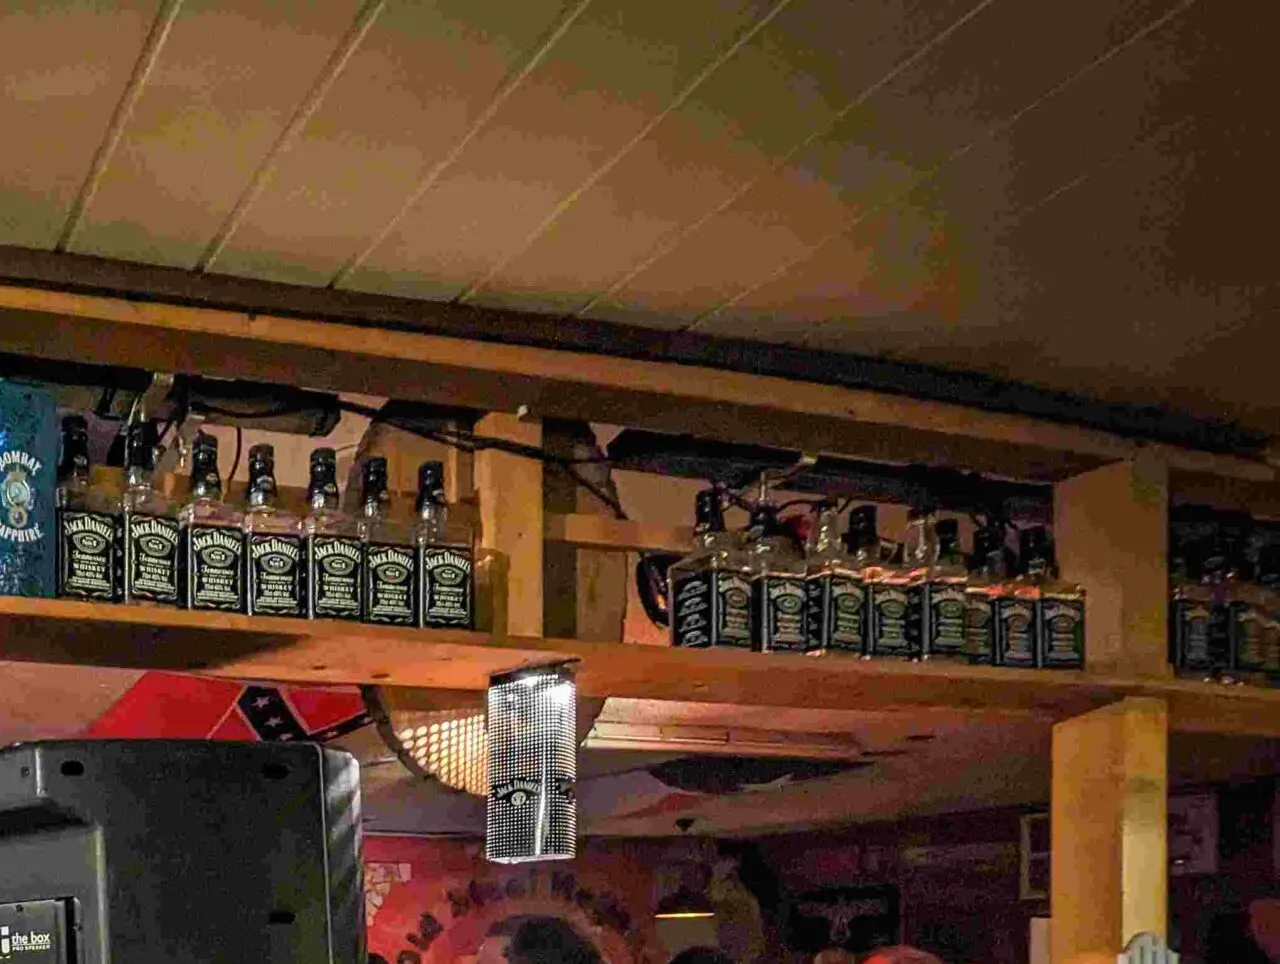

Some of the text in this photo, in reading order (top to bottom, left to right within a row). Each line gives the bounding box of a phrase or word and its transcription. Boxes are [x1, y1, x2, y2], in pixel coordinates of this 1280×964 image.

[63, 520, 84, 536] JACK
[131, 523, 151, 538] JACK
[193, 535, 214, 551] JACK
[251, 543, 272, 558] JACK
[314, 546, 334, 560] JACK
[368, 554, 388, 568] JACK
[425, 556, 444, 570] JACK
[11, 930, 50, 945] the box
